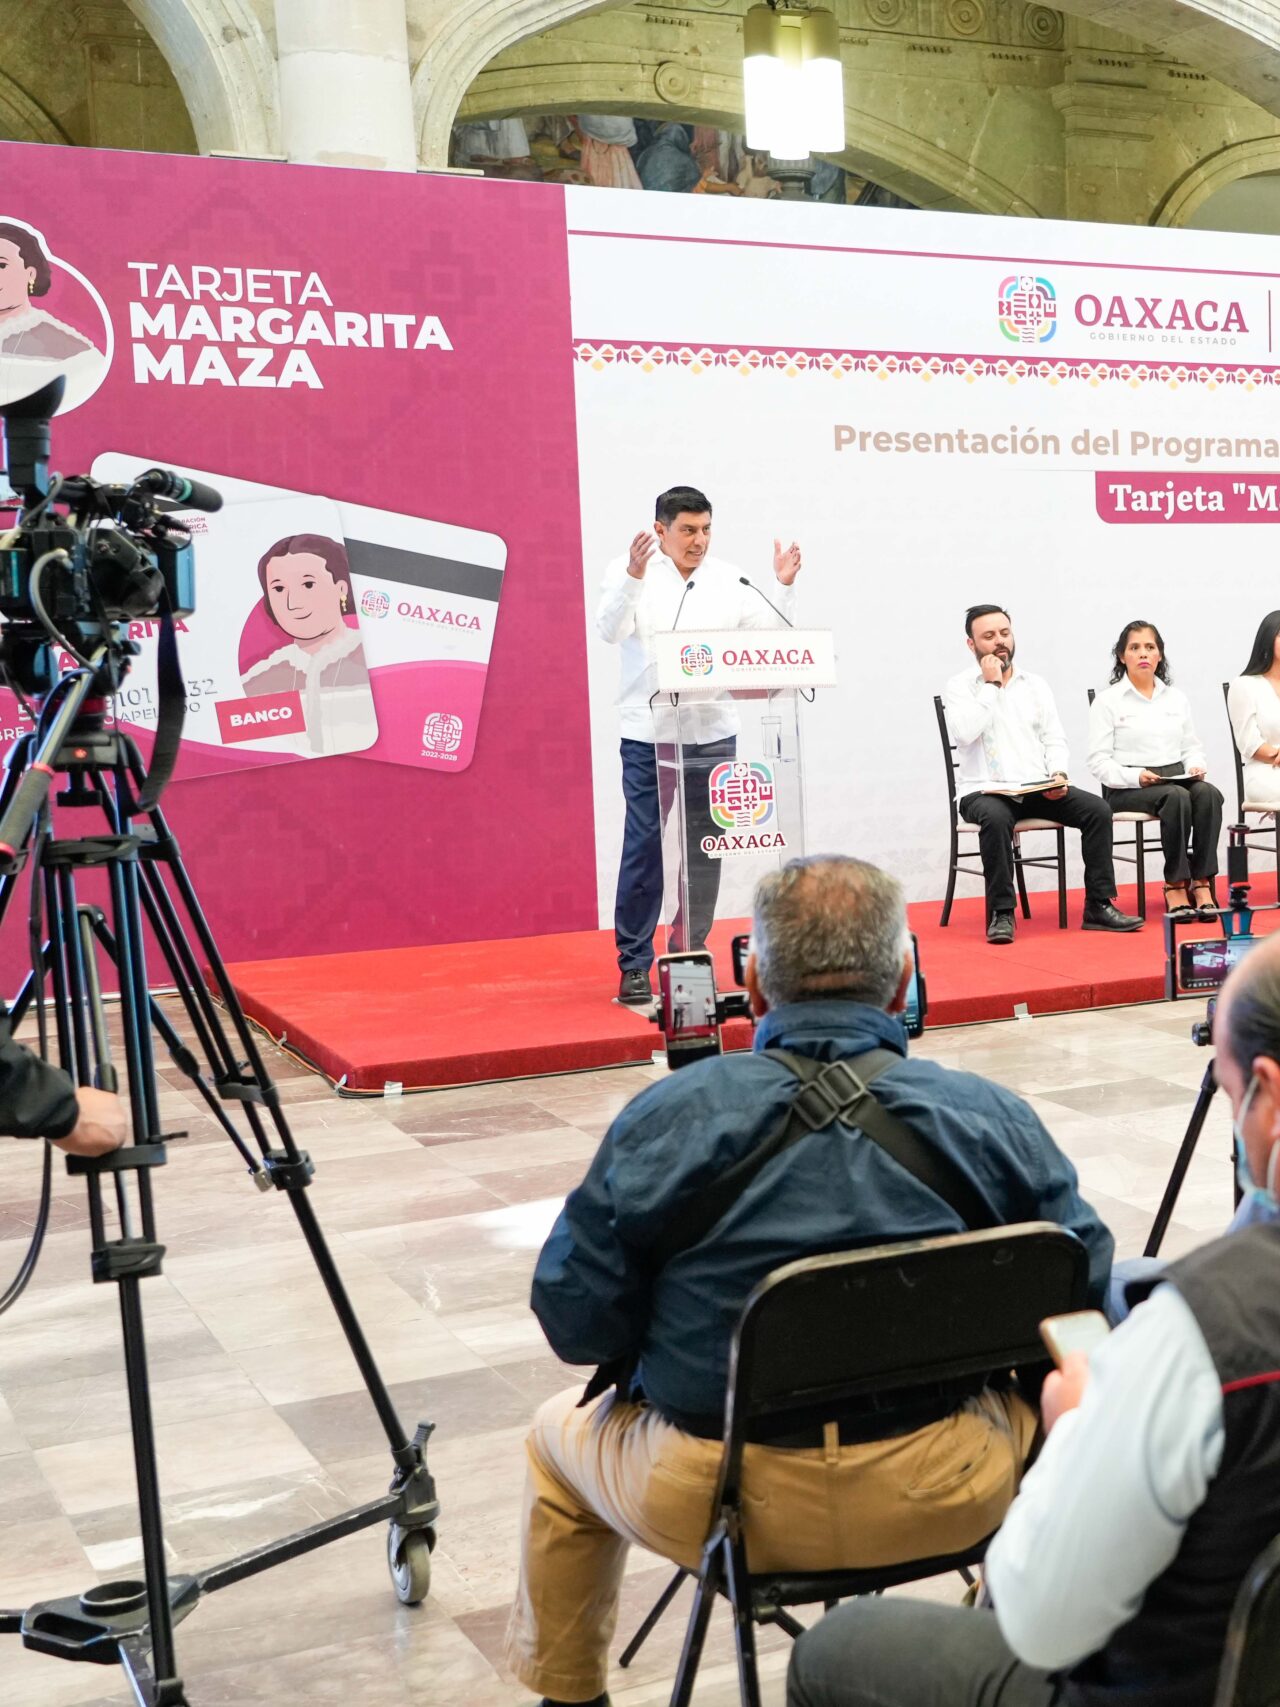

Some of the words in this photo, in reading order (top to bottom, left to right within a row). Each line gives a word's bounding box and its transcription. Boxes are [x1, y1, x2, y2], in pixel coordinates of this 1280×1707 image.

[128, 262, 333, 307] TARJETA
[128, 301, 454, 351] MARGARITA
[1074, 294, 1249, 333] OAXACA
[1090, 332, 1155, 343] GOBIERNO
[1161, 335, 1184, 344] DEL
[1190, 336, 1237, 346] ESTADO
[131, 343, 324, 390] MAZA
[833, 424, 1060, 456] Presentación
[1070, 428, 1120, 457] del
[1130, 431, 1279, 464] Programa
[1108, 480, 1225, 520] Tarjeta
[397, 602, 482, 630] OAXACA
[722, 649, 815, 666] OAXACA
[230, 706, 293, 728] BANCO
[702, 833, 786, 852] OAXACA
